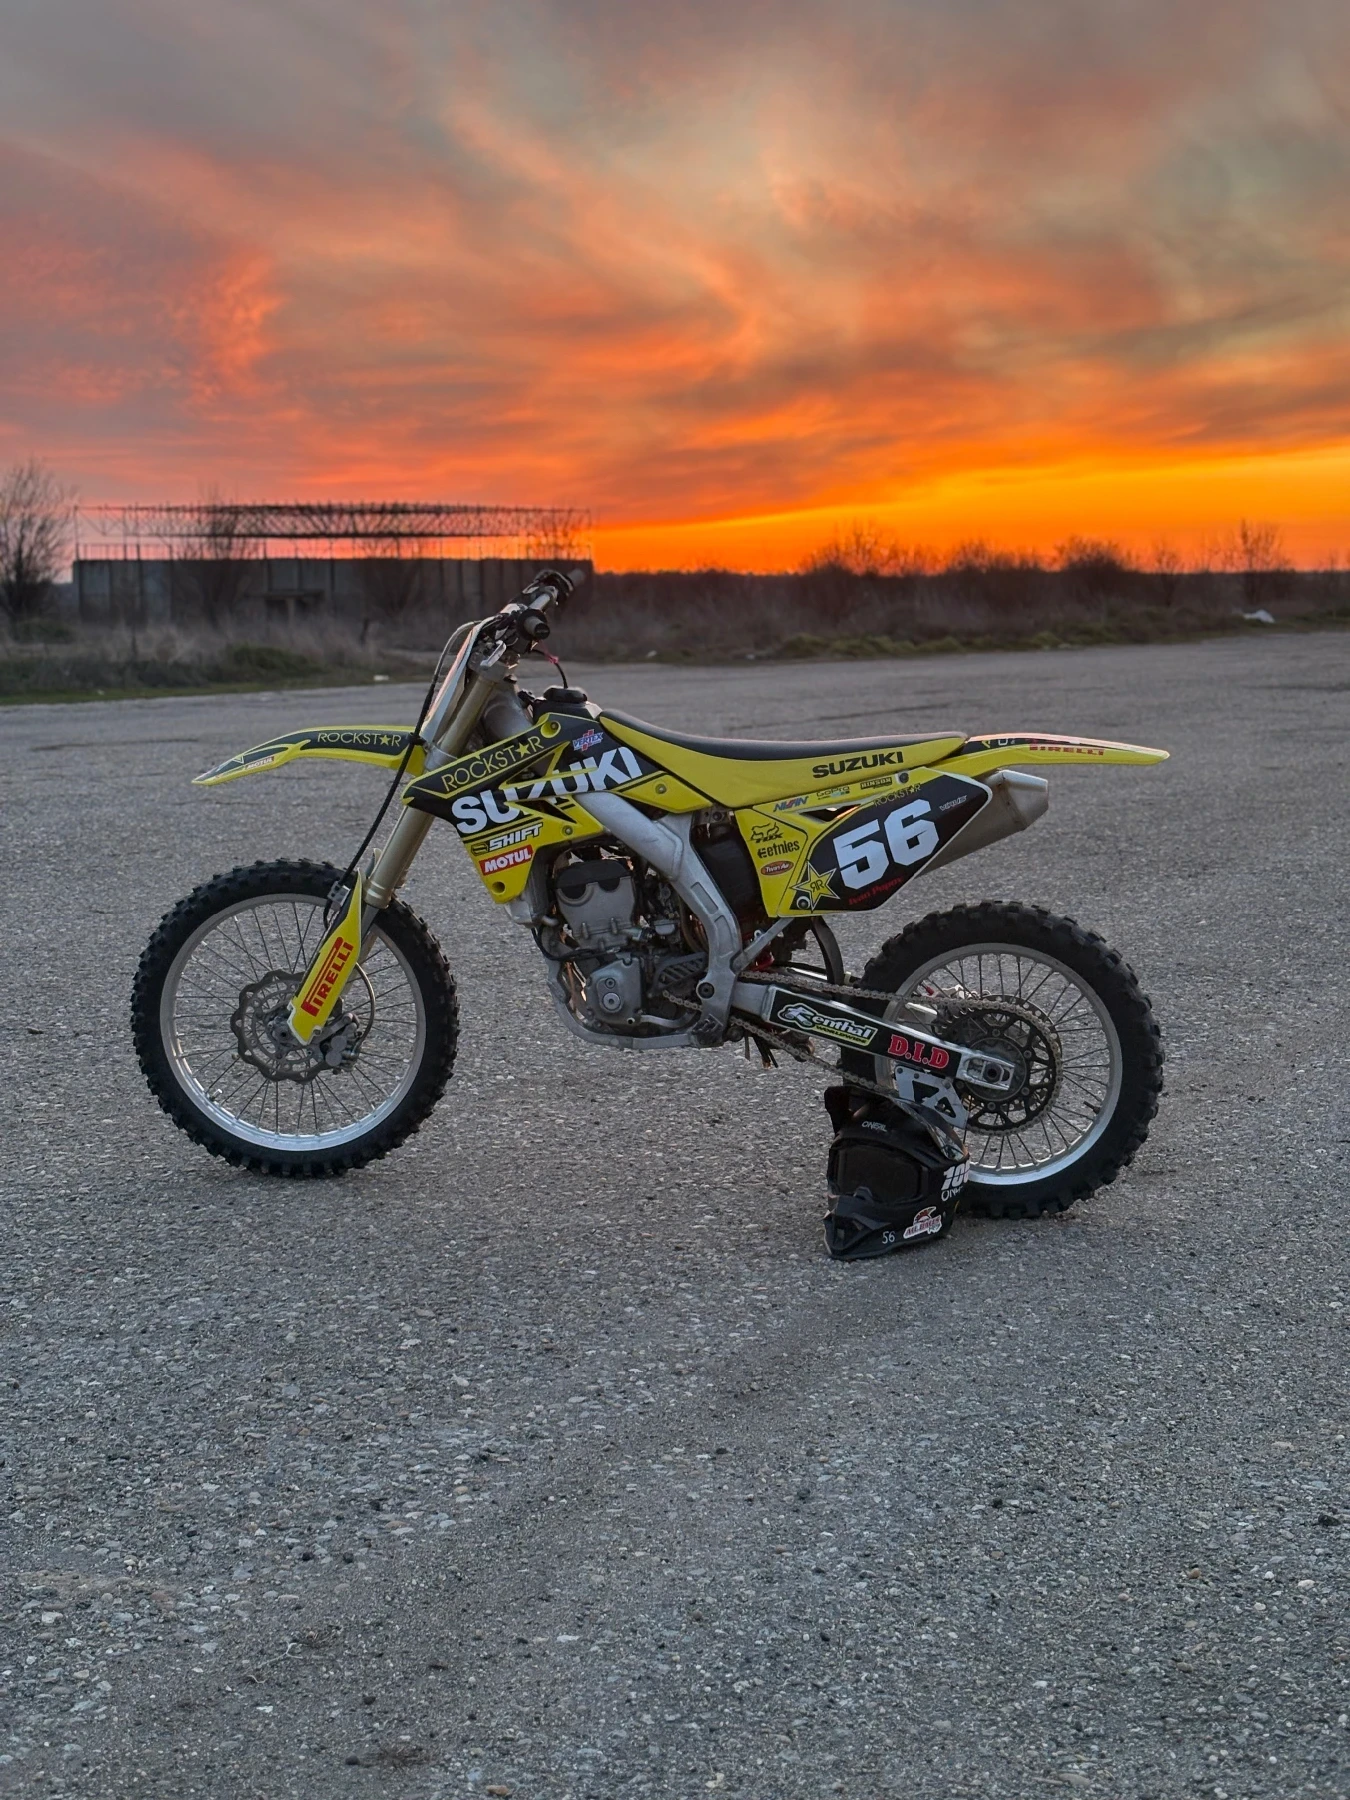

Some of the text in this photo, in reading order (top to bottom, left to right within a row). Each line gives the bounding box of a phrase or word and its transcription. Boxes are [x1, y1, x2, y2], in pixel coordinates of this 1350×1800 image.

[811, 751, 904, 779] SUZUKI
[489, 822, 543, 852] SHIFT
[832, 799, 940, 890] 56
[484, 848, 532, 873] MOTUL
[300, 936, 354, 1017] PIRELLI
[887, 1034, 950, 1069] D.I.D
[882, 1230, 896, 1244] 56
